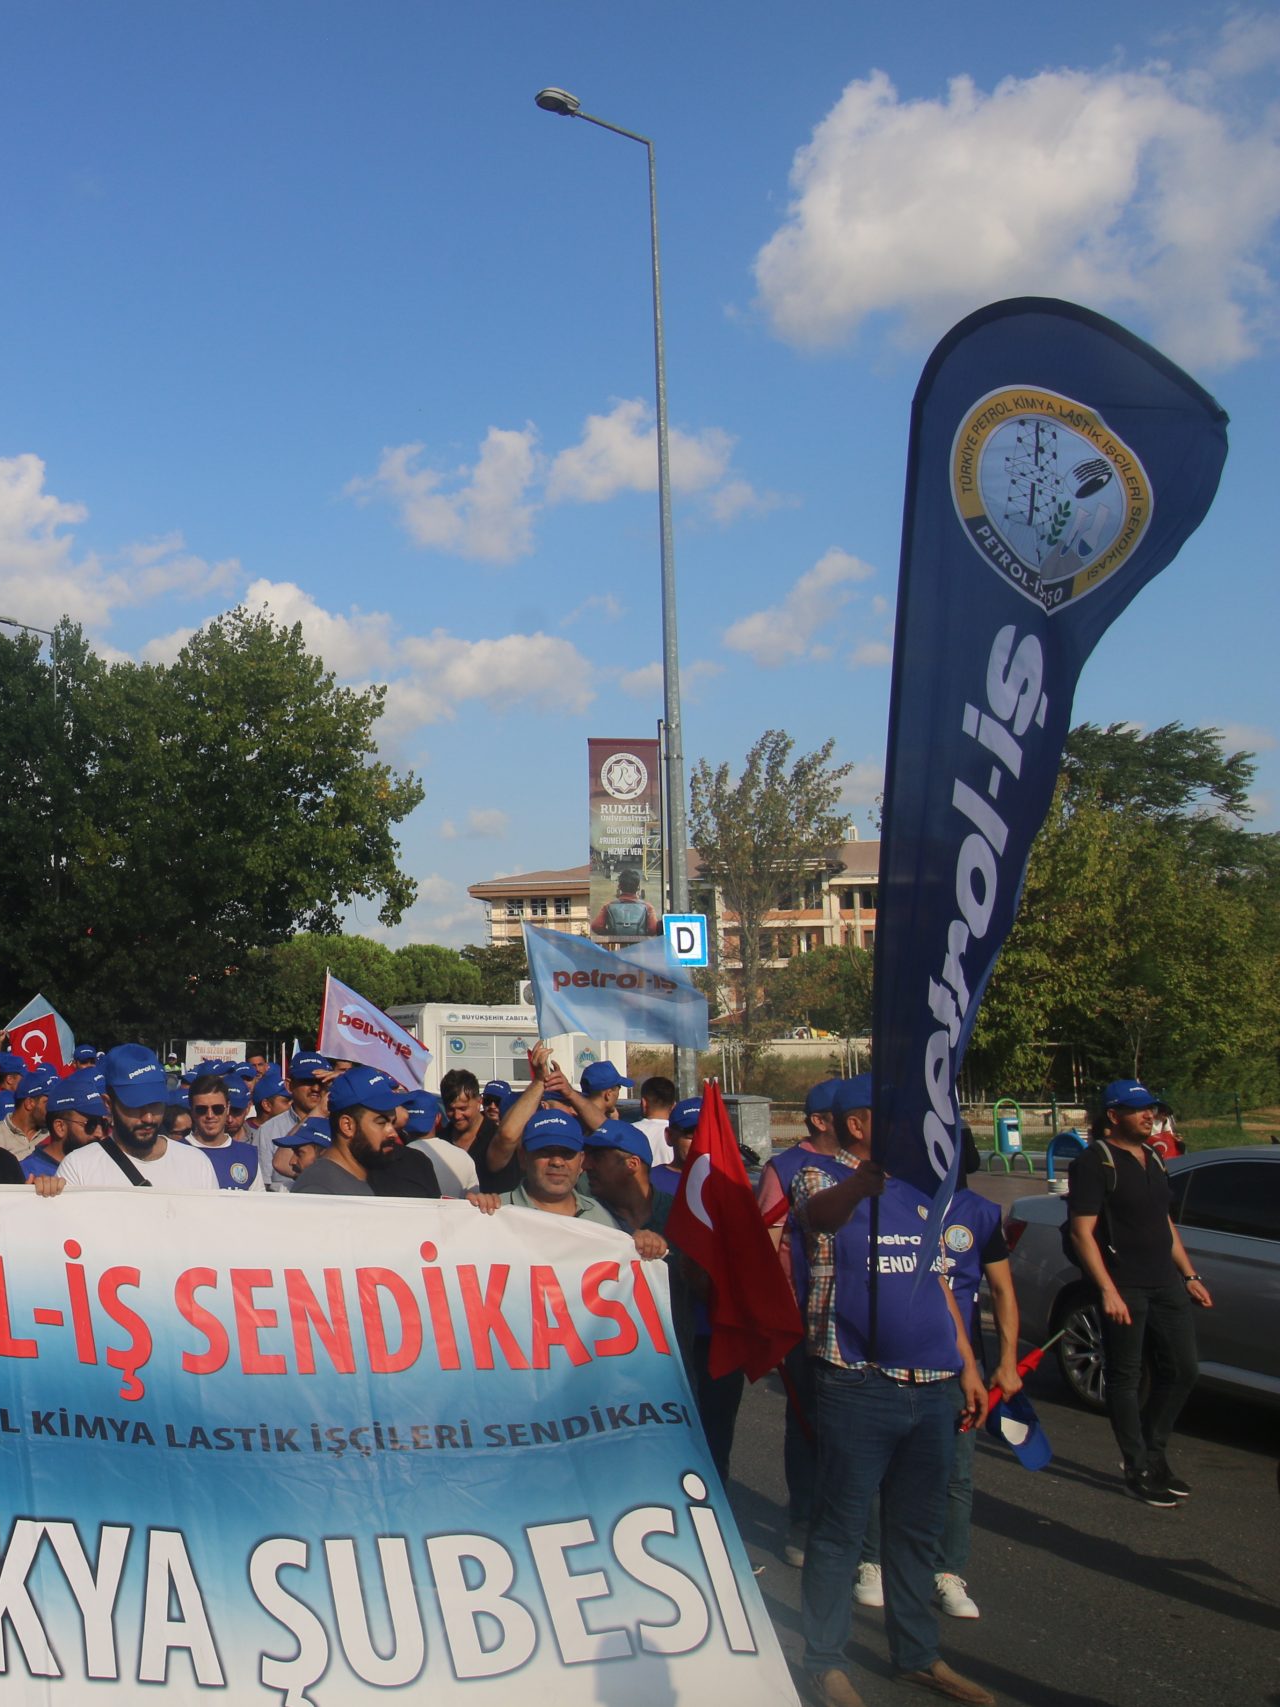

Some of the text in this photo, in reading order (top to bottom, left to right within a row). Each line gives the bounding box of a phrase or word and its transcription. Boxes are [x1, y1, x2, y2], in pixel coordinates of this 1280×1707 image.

[959, 435, 979, 495] TÜRKİYE
[972, 402, 1013, 436] PETROL
[1015, 395, 1055, 413] KİMYA
[1059, 405, 1101, 441] LASTİK
[600, 803, 650, 814] RUMELİ
[676, 927, 695, 953] D
[174, 1240, 672, 1376] SENDİKASI
[31, 1407, 155, 1446] KİMYA
[166, 1423, 298, 1452] LASTİK
[312, 1419, 473, 1458] İŞÇİLERİ
[485, 1401, 692, 1448] SENDİKASI
[246, 1469, 758, 1707] ŞUBESİ
